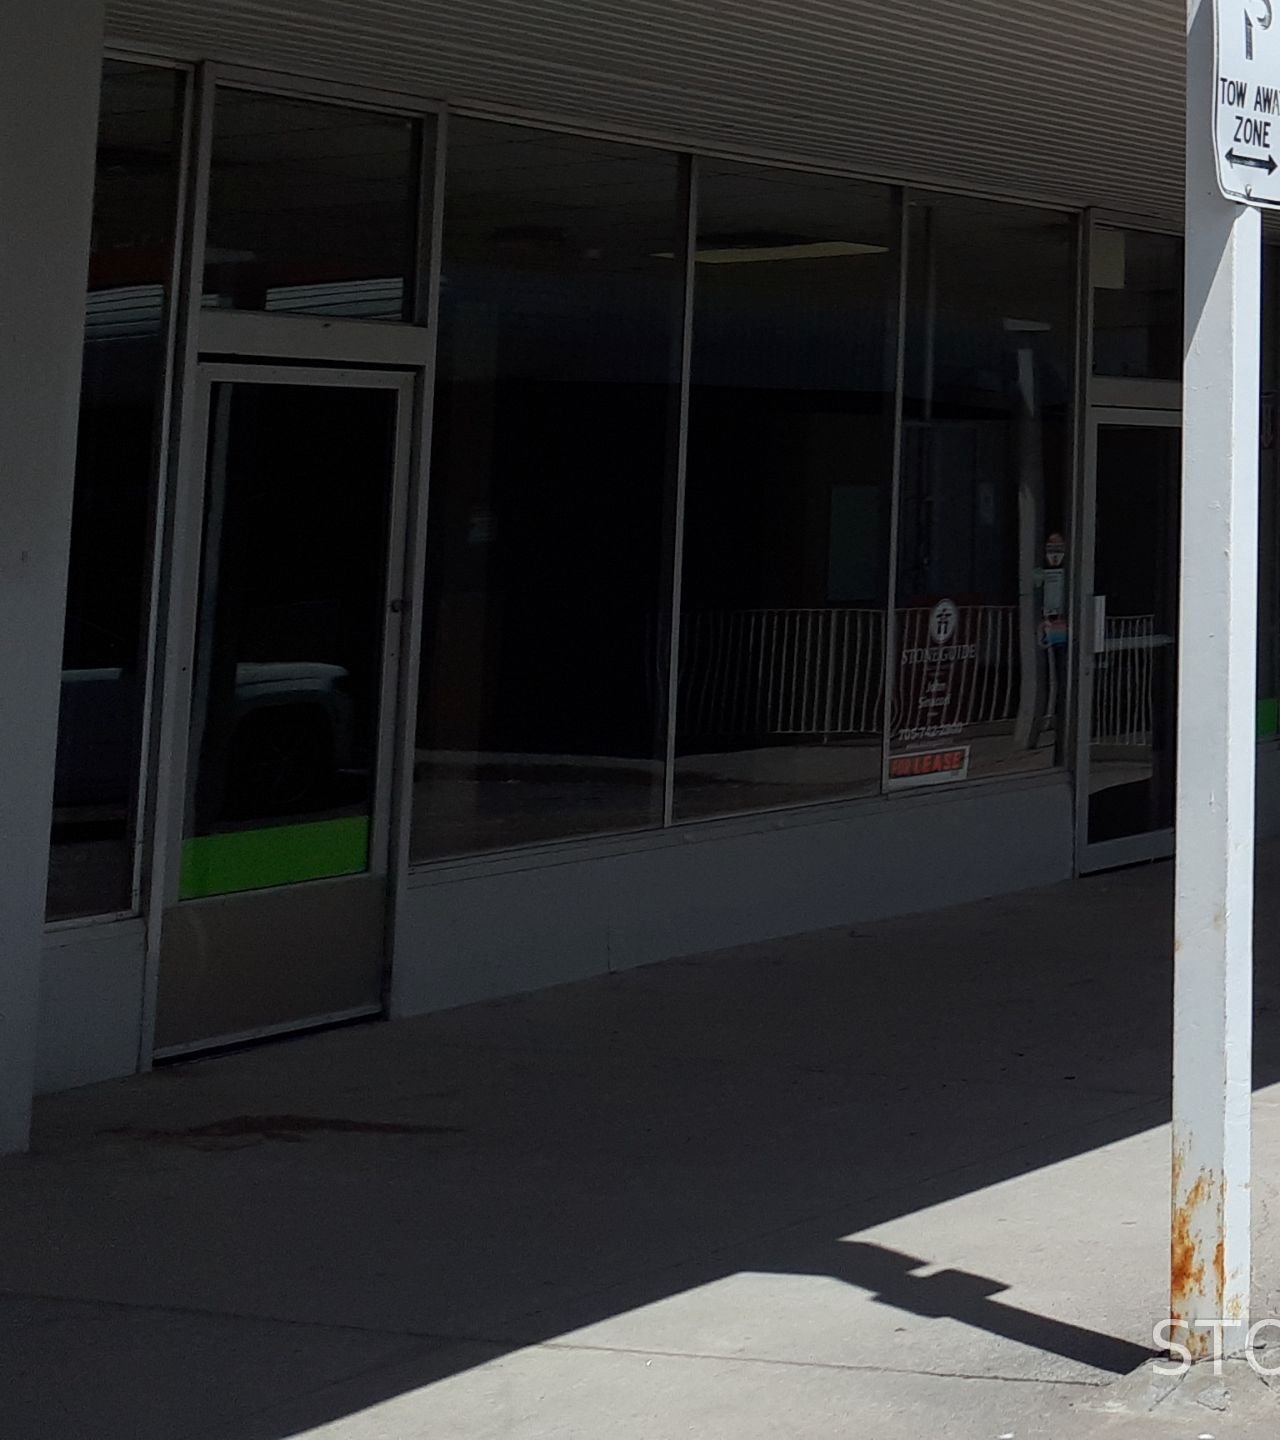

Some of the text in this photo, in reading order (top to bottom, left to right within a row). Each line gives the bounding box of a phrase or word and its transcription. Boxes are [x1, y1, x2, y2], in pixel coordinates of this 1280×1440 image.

[1220, 77, 1247, 108] TOW
[1234, 116, 1271, 148] ZONE
[912, 750, 962, 774] LEASE
